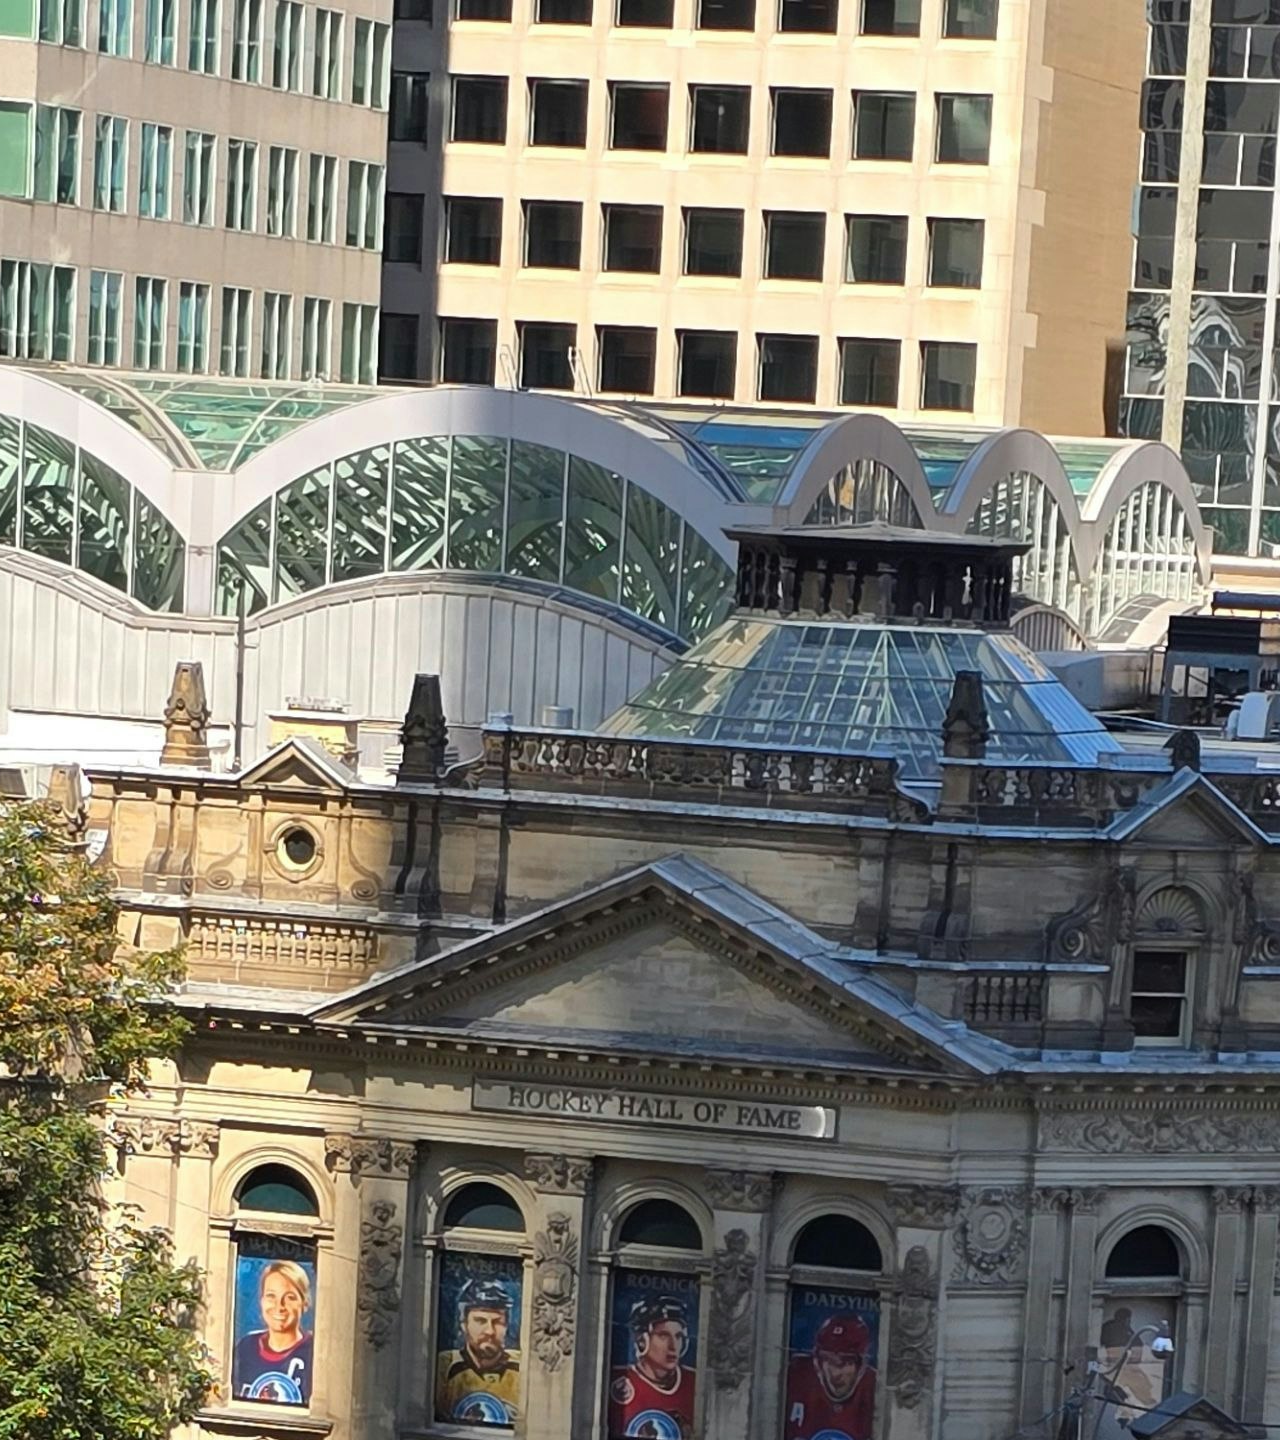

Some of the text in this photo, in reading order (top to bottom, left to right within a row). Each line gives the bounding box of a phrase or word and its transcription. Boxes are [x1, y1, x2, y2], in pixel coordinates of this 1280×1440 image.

[508, 1087, 802, 1131] HOCKEY HALL OF FAME
[804, 1291, 881, 1313] DATSYUK
[790, 1402, 805, 1428] A
